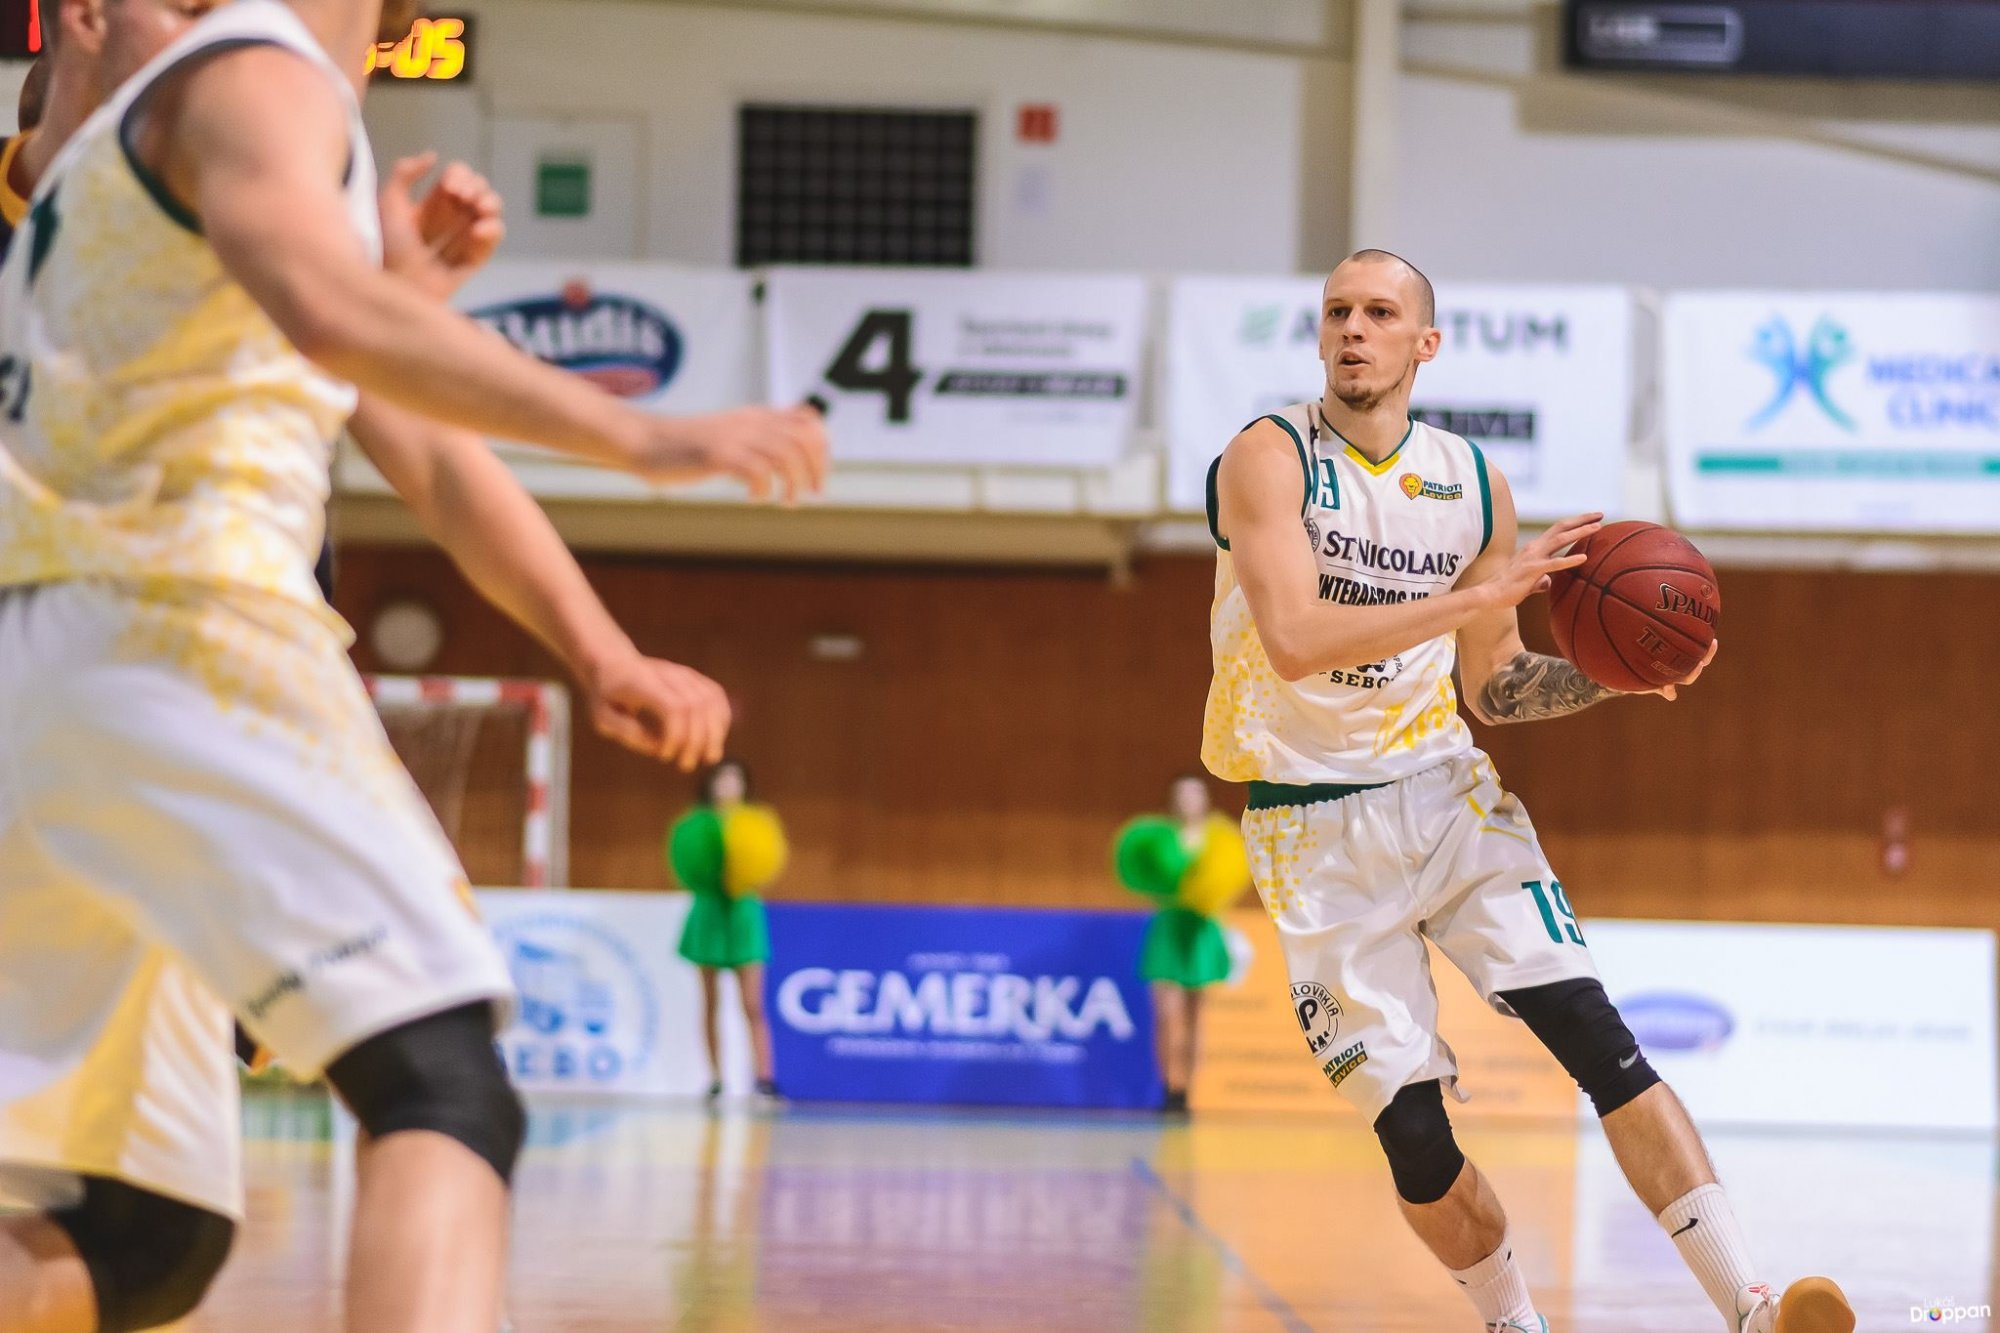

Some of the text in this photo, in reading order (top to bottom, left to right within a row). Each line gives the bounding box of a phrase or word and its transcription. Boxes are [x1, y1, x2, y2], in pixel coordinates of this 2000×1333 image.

[1423, 480, 1463, 492] PATRIOTI
[777, 967, 1134, 1041] GEMERKA
[1291, 984, 1340, 1017] LOVAKIA
